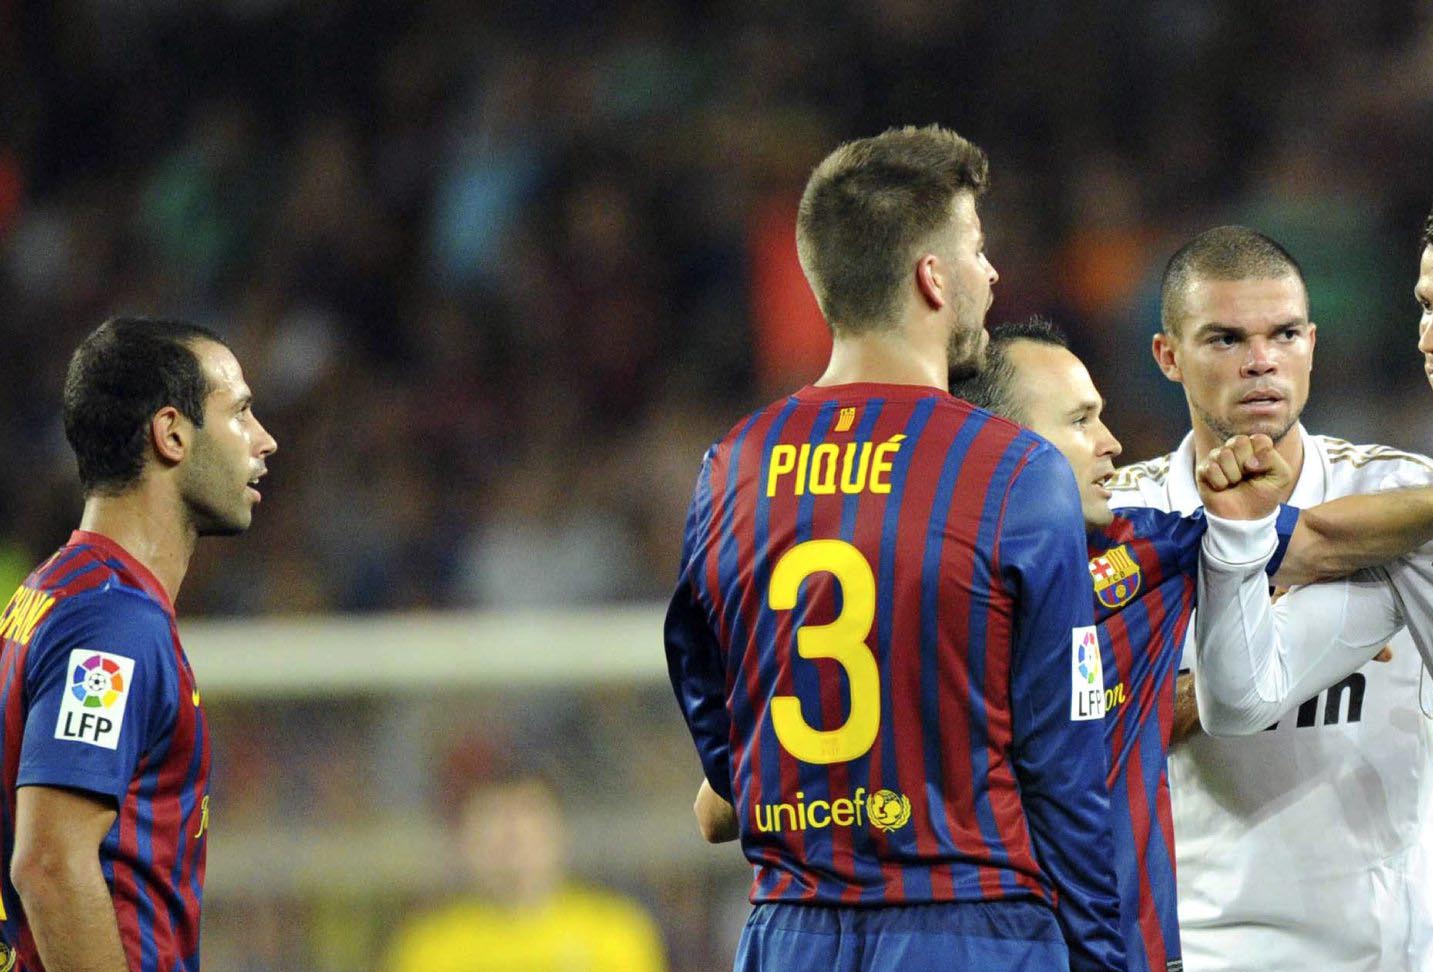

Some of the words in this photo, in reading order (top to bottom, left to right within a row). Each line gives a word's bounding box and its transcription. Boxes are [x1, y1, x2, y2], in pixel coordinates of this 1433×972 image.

[766, 433, 906, 498] PIQUÉ
[1107, 570, 1127, 585] FCB
[768, 538, 881, 765] 3
[1079, 689, 1102, 718] LFP
[63, 711, 113, 743] LFP
[755, 787, 865, 832] unicef
